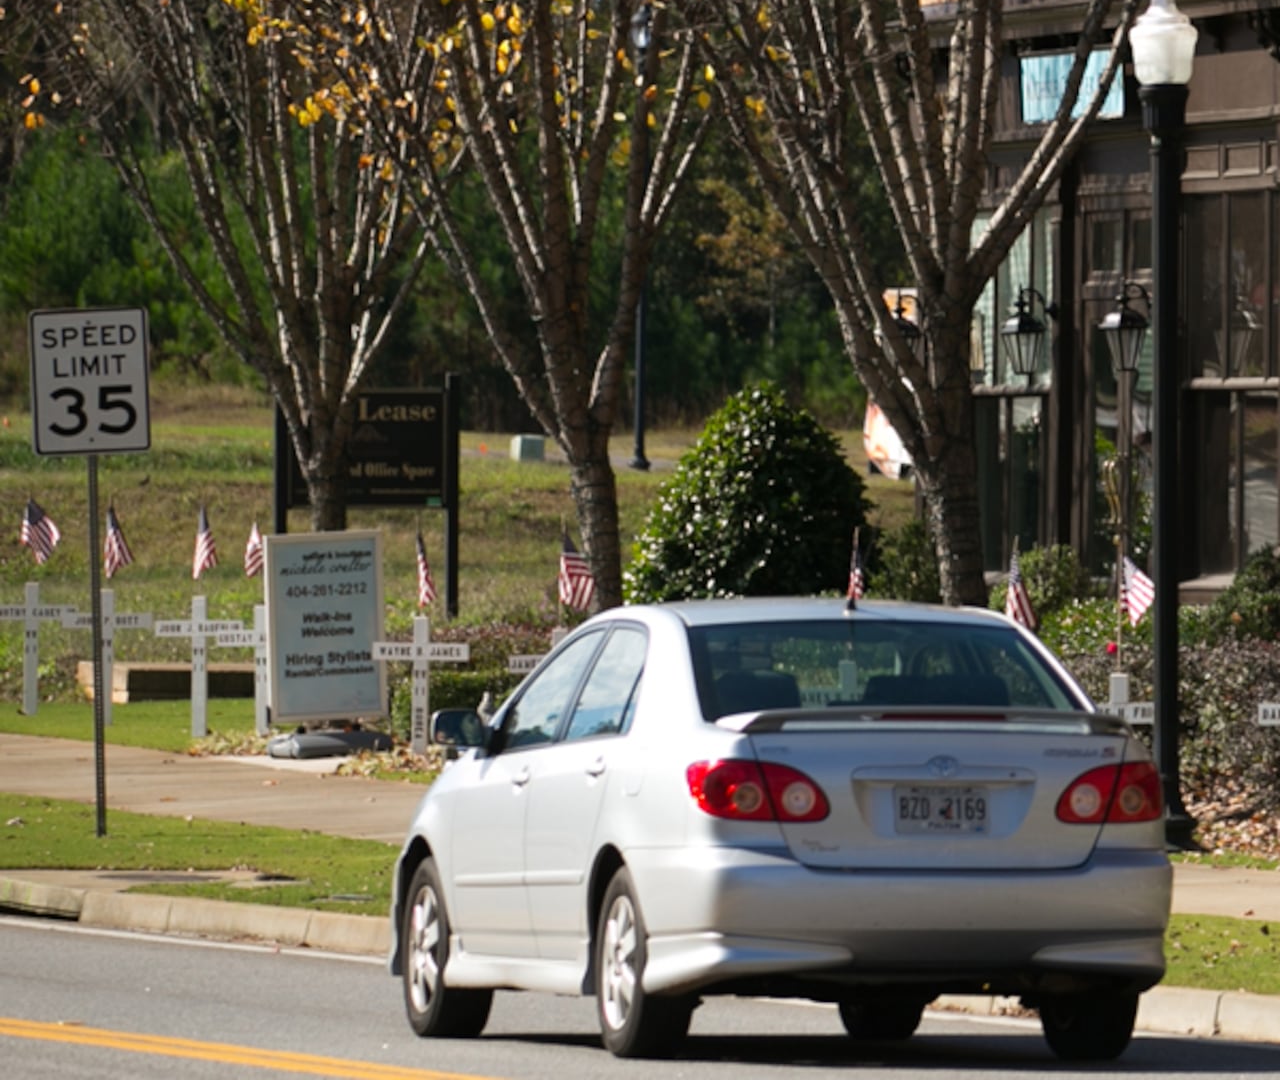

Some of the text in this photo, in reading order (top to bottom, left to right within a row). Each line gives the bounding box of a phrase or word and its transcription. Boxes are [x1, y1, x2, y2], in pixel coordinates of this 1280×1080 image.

[42, 324, 136, 349] SPEED
[53, 354, 126, 378] LIMIT
[49, 385, 137, 437] 35
[358, 398, 436, 422] Lease
[286, 650, 372, 666] Hiring Stylists
[380, 647, 411, 657] WAYNE
[430, 647, 462, 657] JAMES
